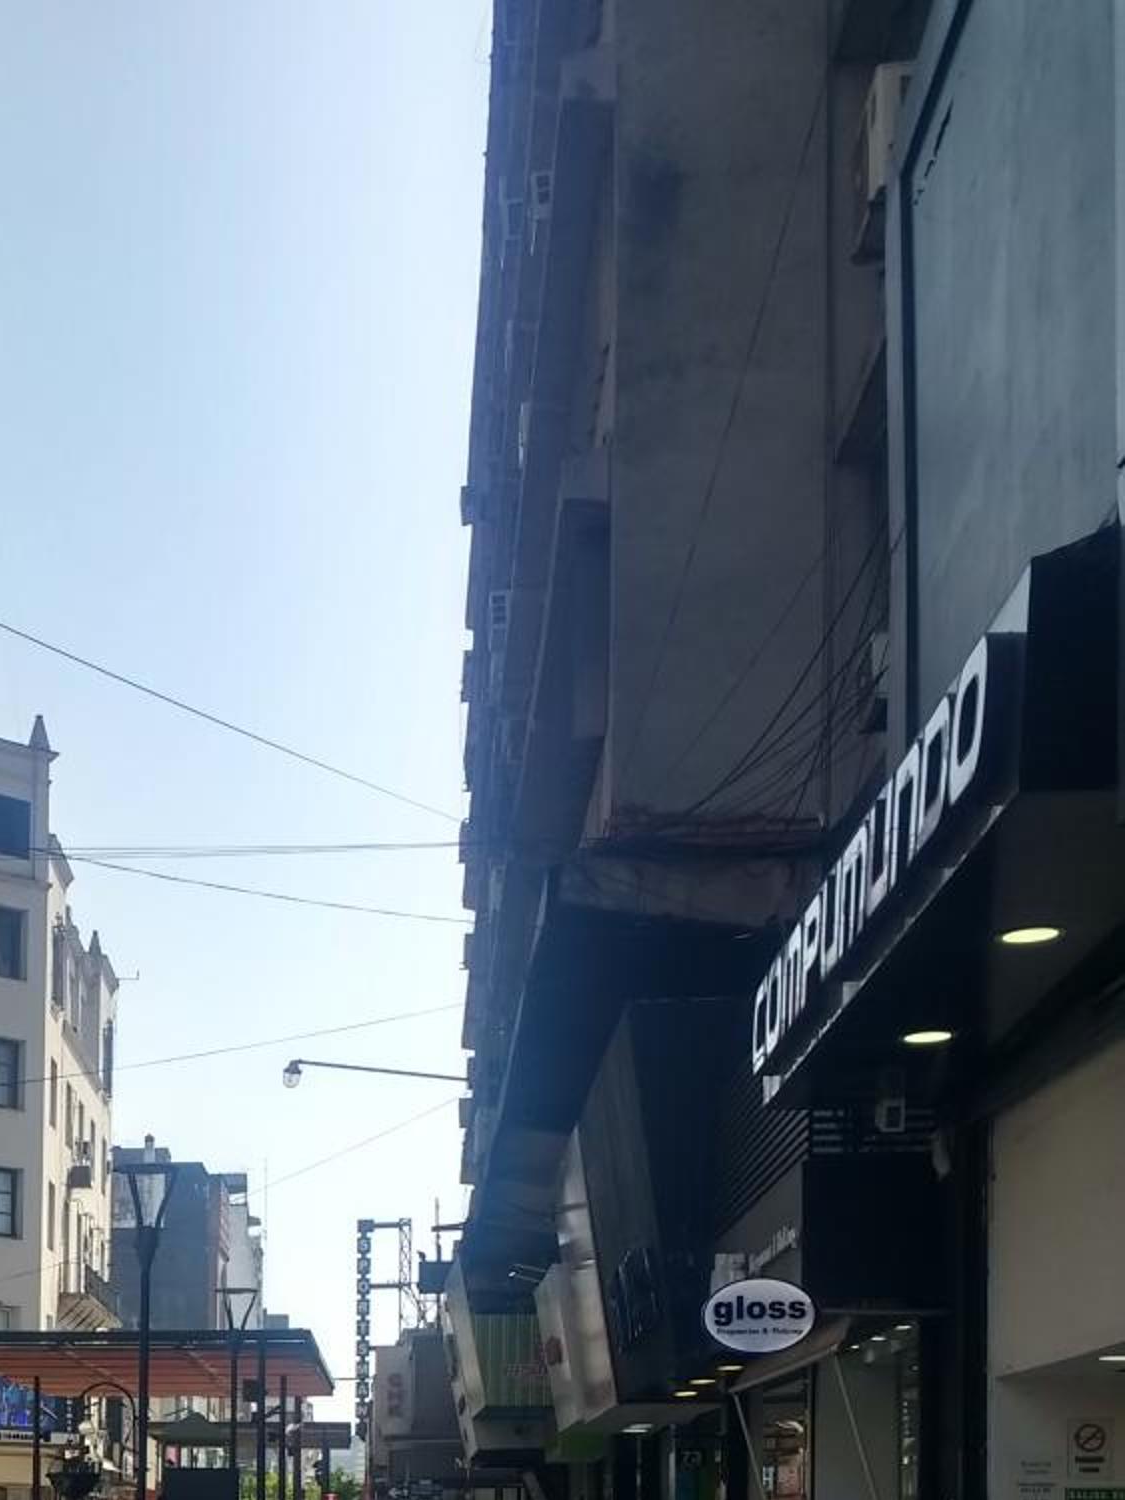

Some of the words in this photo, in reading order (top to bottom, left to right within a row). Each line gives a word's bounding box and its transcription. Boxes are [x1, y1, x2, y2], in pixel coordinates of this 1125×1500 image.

[753, 634, 988, 1075] COMPUMUNDO
[357, 1239, 371, 1418] SPORTSMAN
[713, 1295, 807, 1326] gloss
